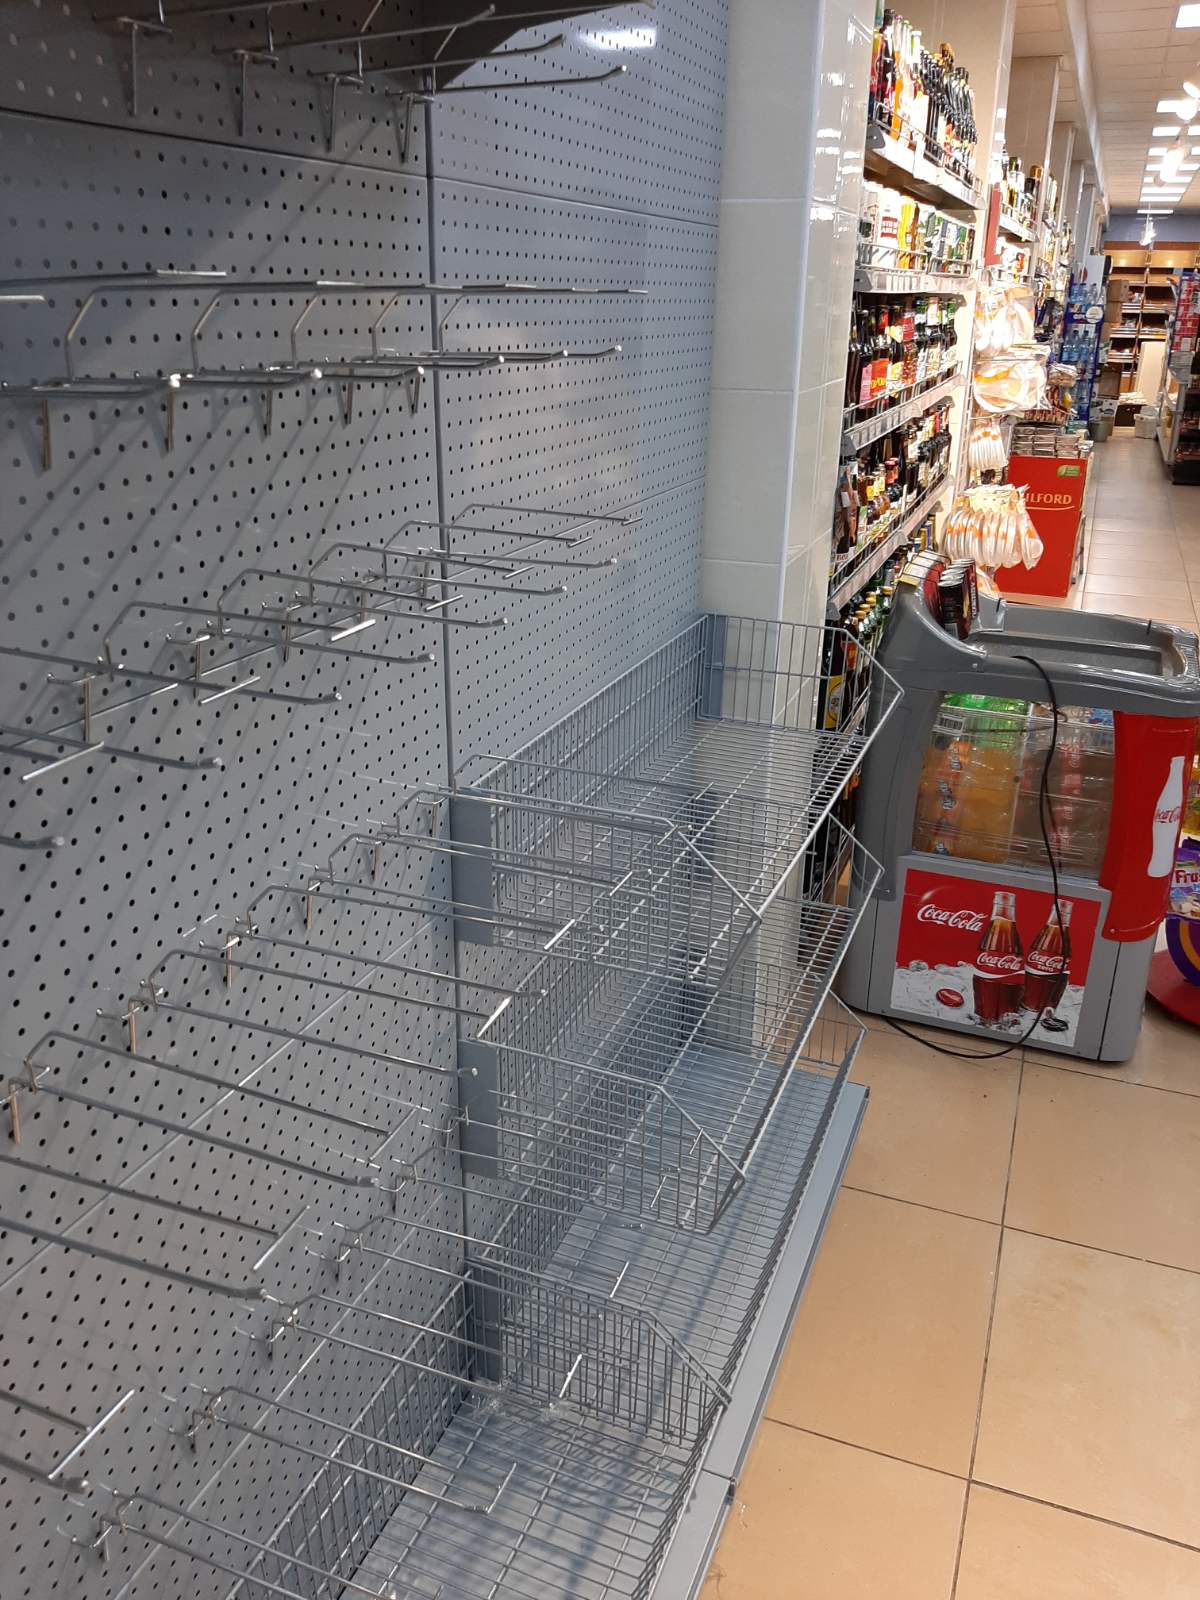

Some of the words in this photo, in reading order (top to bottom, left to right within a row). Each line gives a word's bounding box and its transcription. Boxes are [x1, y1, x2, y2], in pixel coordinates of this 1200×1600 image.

[1025, 493, 1072, 504] ILFORD
[1175, 869, 1200, 884] Fru
[917, 904, 988, 932] Coca-Cola
[976, 952, 1023, 971] Coca-Cola
